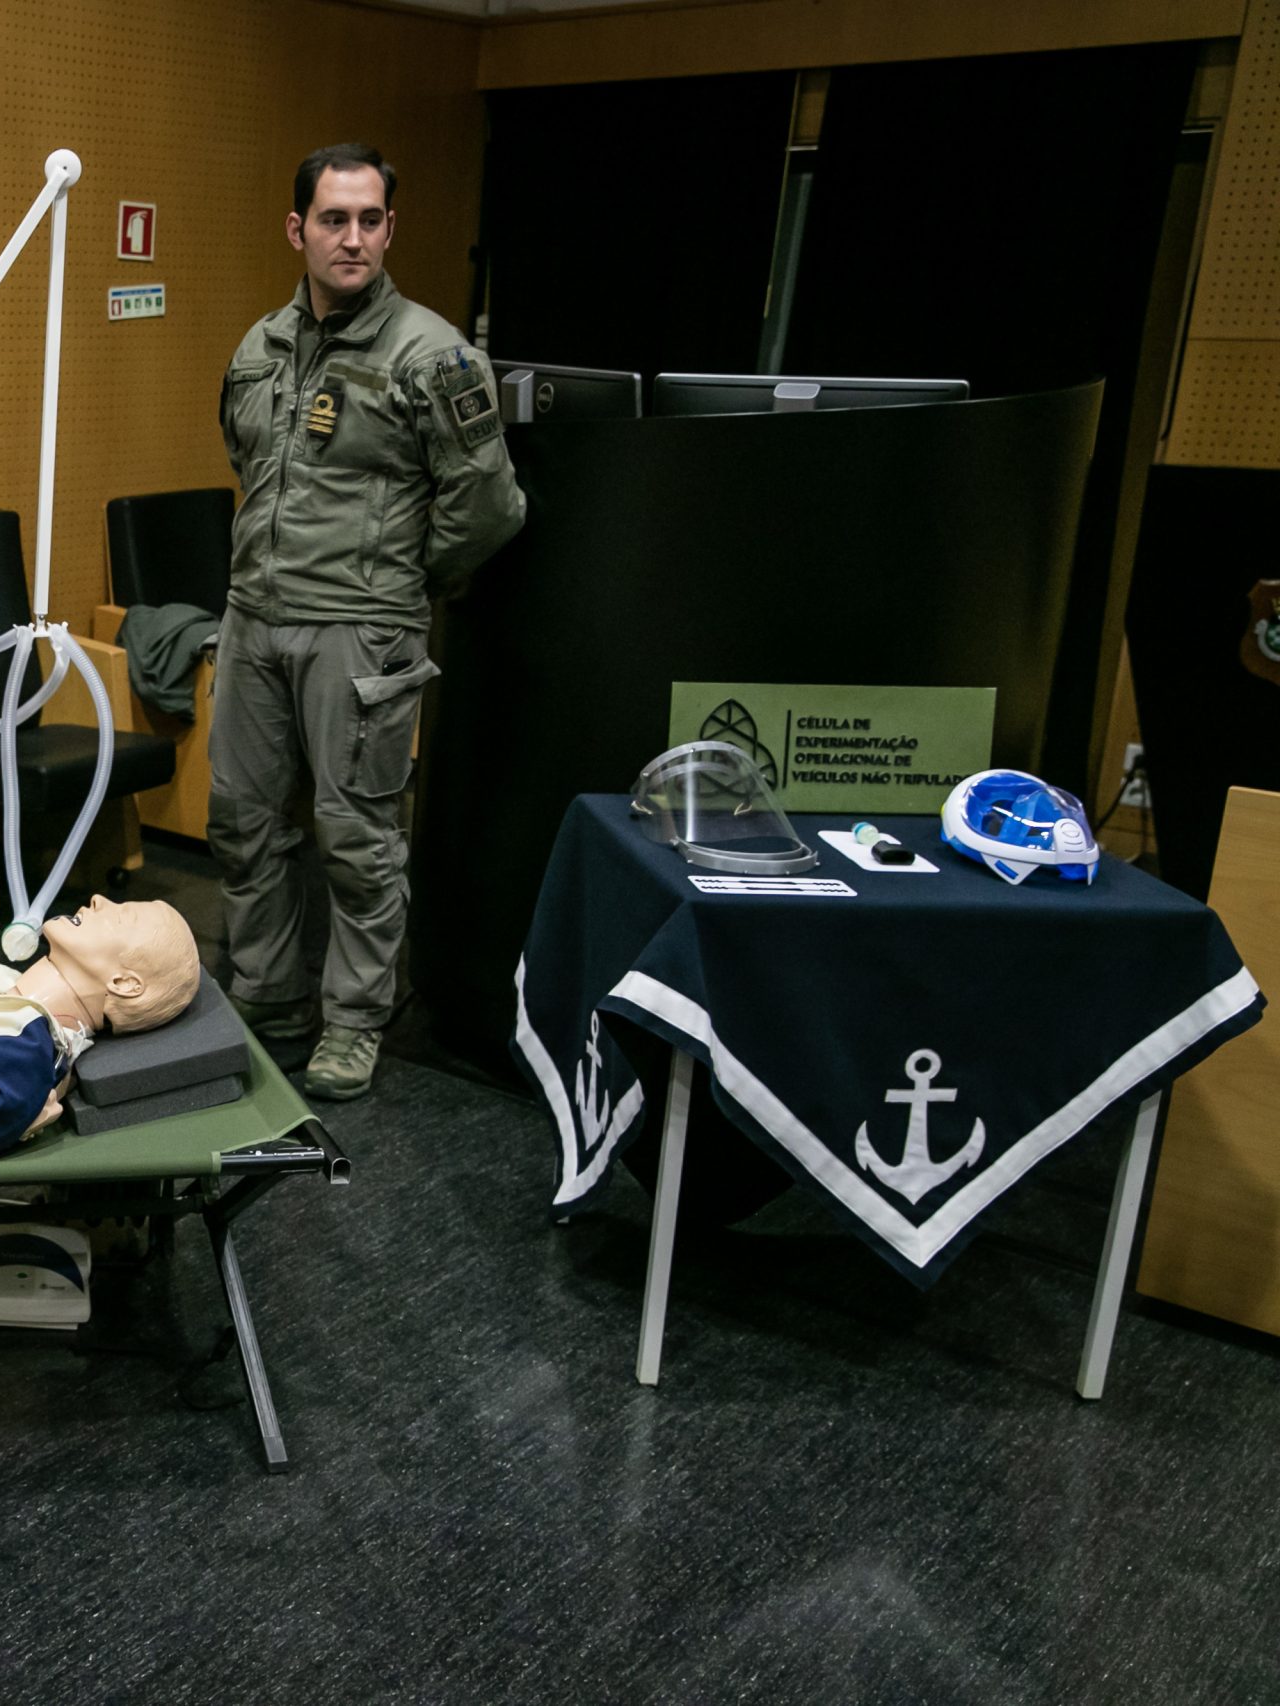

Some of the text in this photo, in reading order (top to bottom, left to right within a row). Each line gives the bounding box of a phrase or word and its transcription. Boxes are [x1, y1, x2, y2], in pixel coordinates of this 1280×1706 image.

[797, 715, 871, 730] CÉLULA DE
[795, 735, 919, 752] EXPERIMENTAÇÃO
[794, 753, 912, 767] OPERACIONAL DE
[792, 770, 858, 785] VEÍCULOS
[861, 771, 891, 785] NÃO
